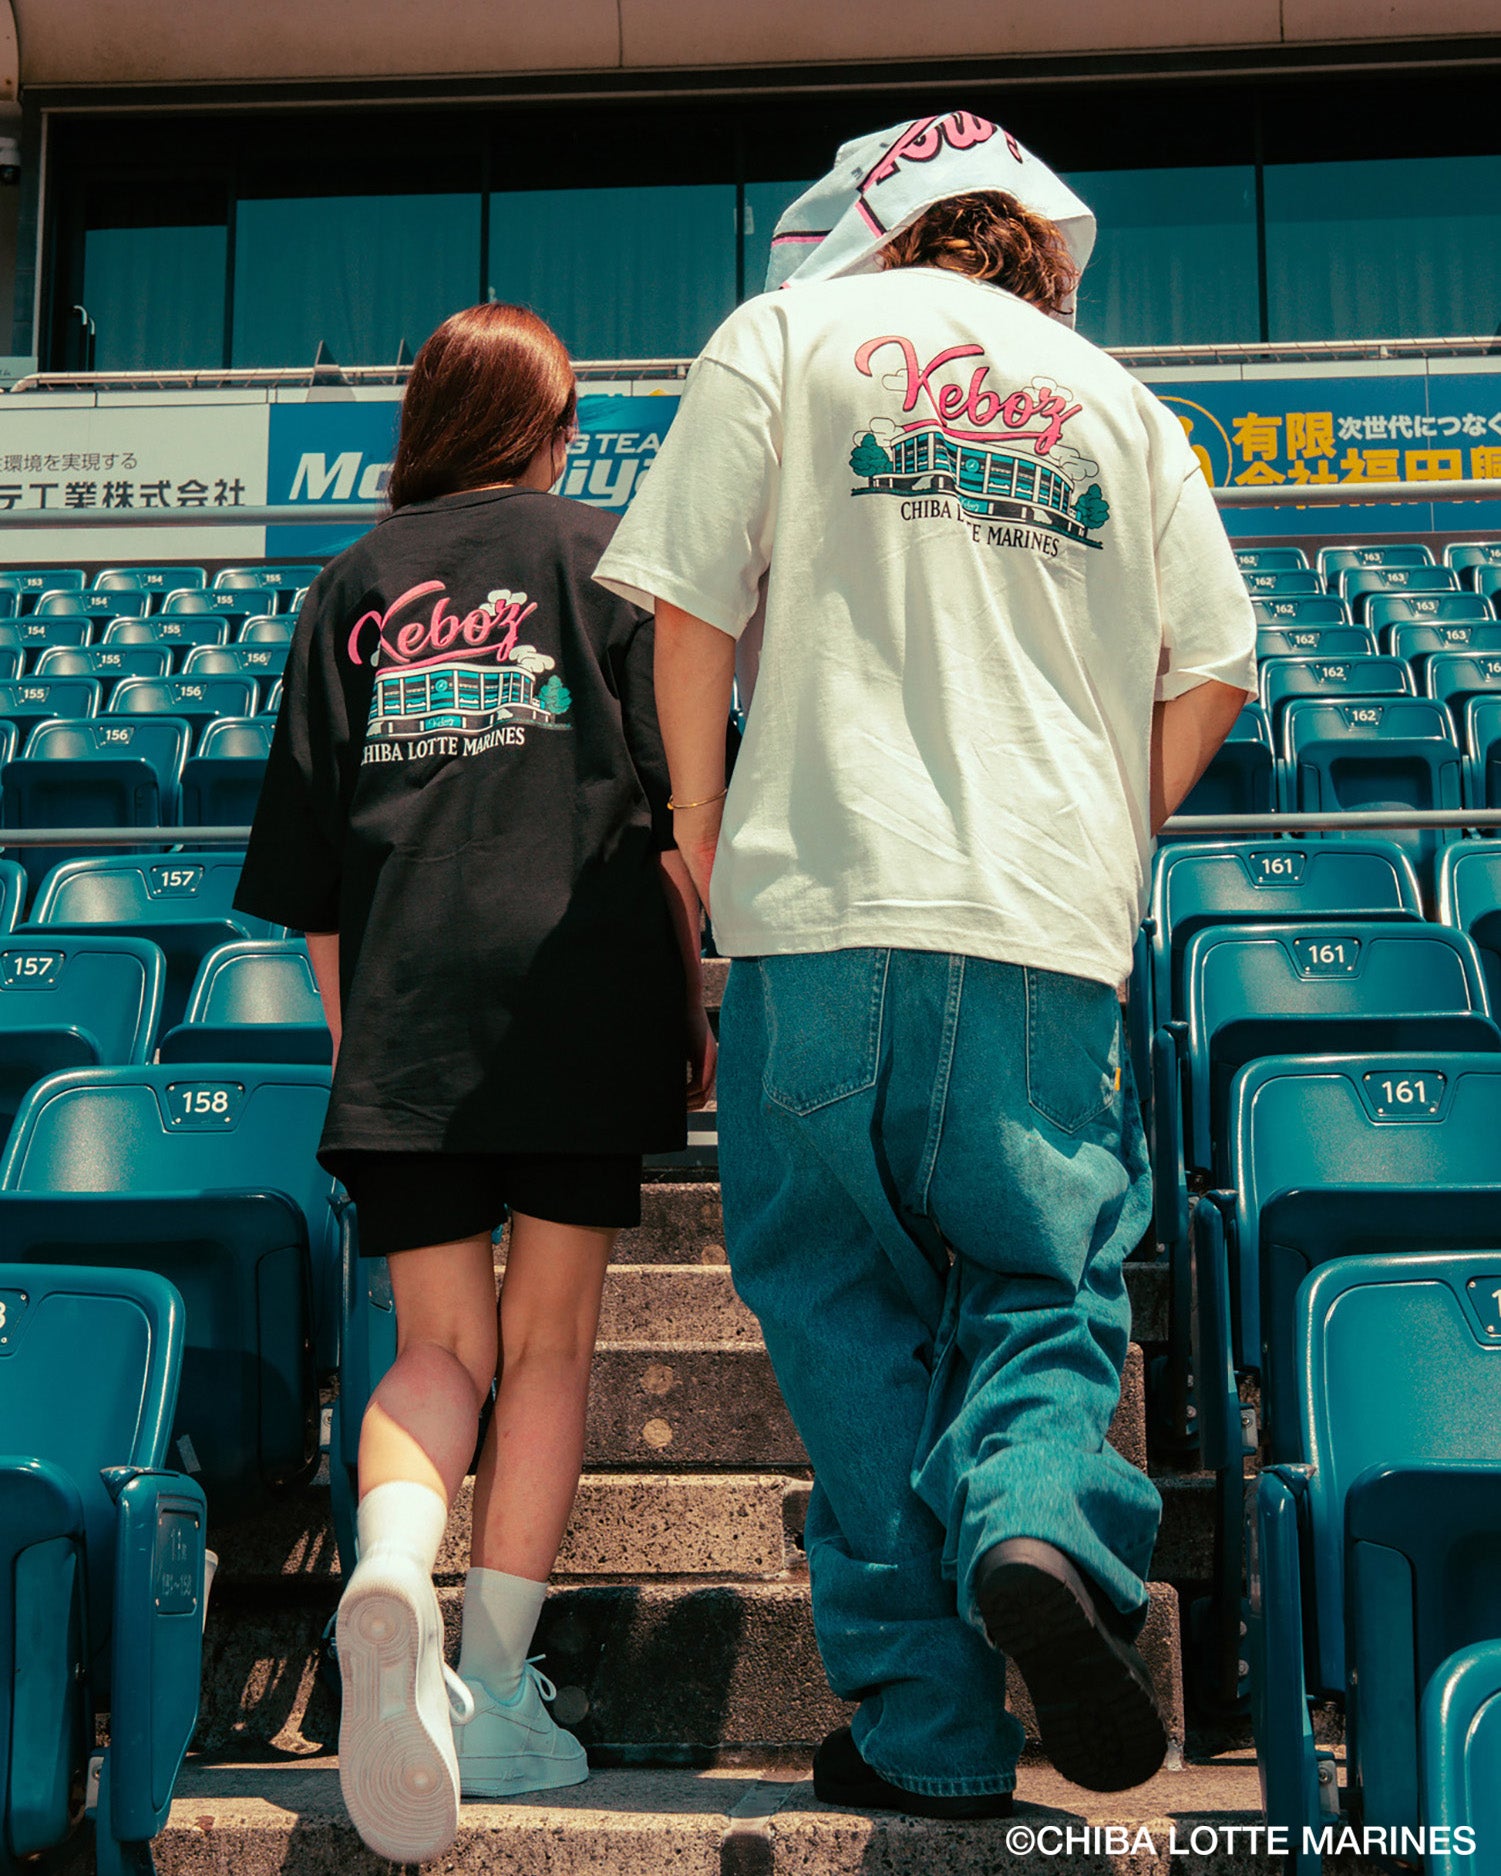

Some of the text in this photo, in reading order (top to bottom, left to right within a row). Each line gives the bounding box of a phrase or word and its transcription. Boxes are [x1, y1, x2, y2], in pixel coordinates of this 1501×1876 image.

[854, 335, 1083, 455] Keboz
[901, 498, 1060, 557] CHIBA MARINES
[1490, 549, 1501, 558] 16
[163, 624, 181, 635] 155
[1295, 634, 1315, 645] 162
[101, 654, 120, 665] 155
[247, 653, 267, 664] 156
[1322, 666, 1344, 678] 162
[1488, 662, 1501, 672] 16
[24, 688, 45, 699] 155
[180, 686, 201, 697] 156
[1352, 709, 1376, 722] 162
[105, 729, 128, 741] 156
[361, 726, 526, 767] HIBA LOTTE MARINES
[1262, 858, 1293, 874] 161
[161, 871, 194, 887] 157
[1308, 945, 1345, 964] 161
[14, 957, 54, 976] 157
[1382, 1080, 1426, 1104] 161
[182, 1091, 229, 1113] 158
